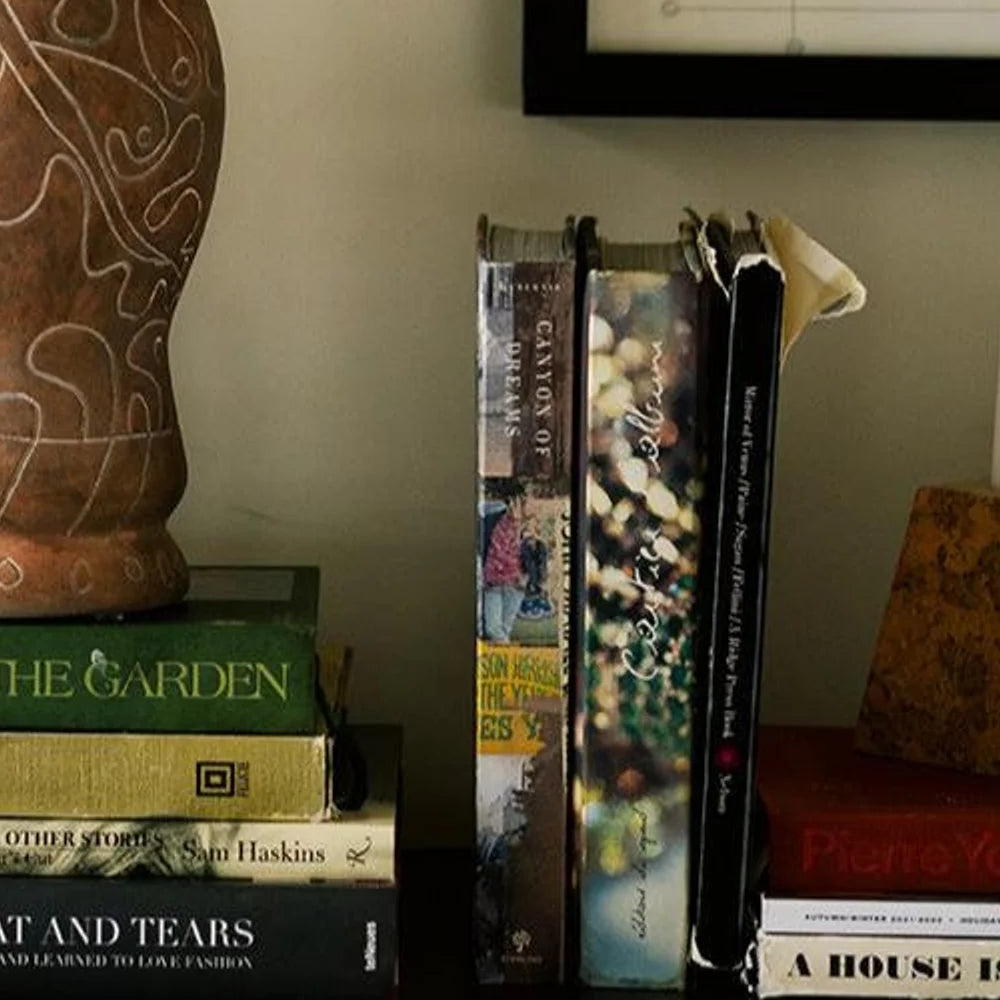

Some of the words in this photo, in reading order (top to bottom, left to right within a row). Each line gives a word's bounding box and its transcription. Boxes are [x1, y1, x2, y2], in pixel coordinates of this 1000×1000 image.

[535, 320, 552, 416] CANYON
[504, 341, 522, 438] DREAMS
[535, 429, 551, 457] OF
[84, 661, 288, 701] GARDEN
[4, 831, 76, 847] OTHER
[183, 838, 229, 863] Sam
[238, 840, 326, 864] Haskins
[41, 916, 121, 945] AND
[130, 917, 256, 948] TEARS
[0, 952, 30, 966] AND
[33, 953, 108, 967] LEARNED
[112, 954, 135, 968] TO
[138, 954, 181, 968] LOVE
[185, 955, 254, 969] FASHION
[787, 953, 811, 977] A
[829, 954, 961, 981] HOUSE
